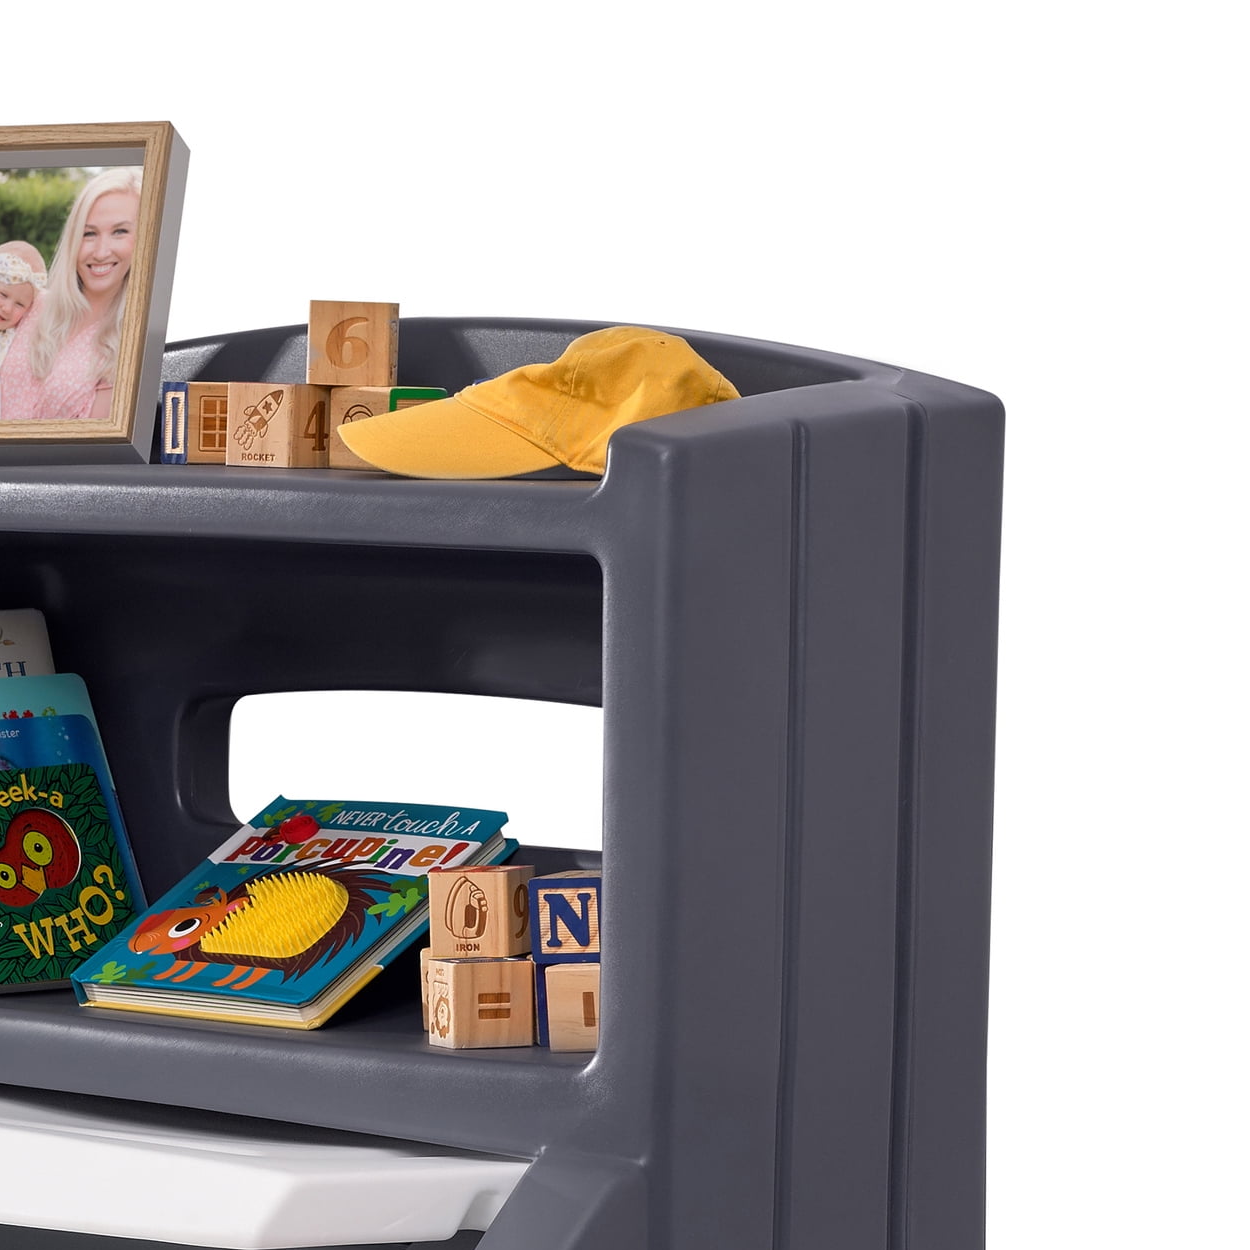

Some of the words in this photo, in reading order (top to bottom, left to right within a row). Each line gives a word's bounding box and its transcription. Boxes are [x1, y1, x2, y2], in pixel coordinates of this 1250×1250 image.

[326, 316, 370, 369] 6
[303, 401, 329, 451] 4
[240, 452, 276, 462] ROCKET
[329, 809, 387, 827] NEVER
[382, 809, 462, 836] touch
[12, 864, 125, 960] WHO?
[513, 884, 529, 939] 9
[543, 892, 591, 947] N
[455, 943, 480, 952] IRON
